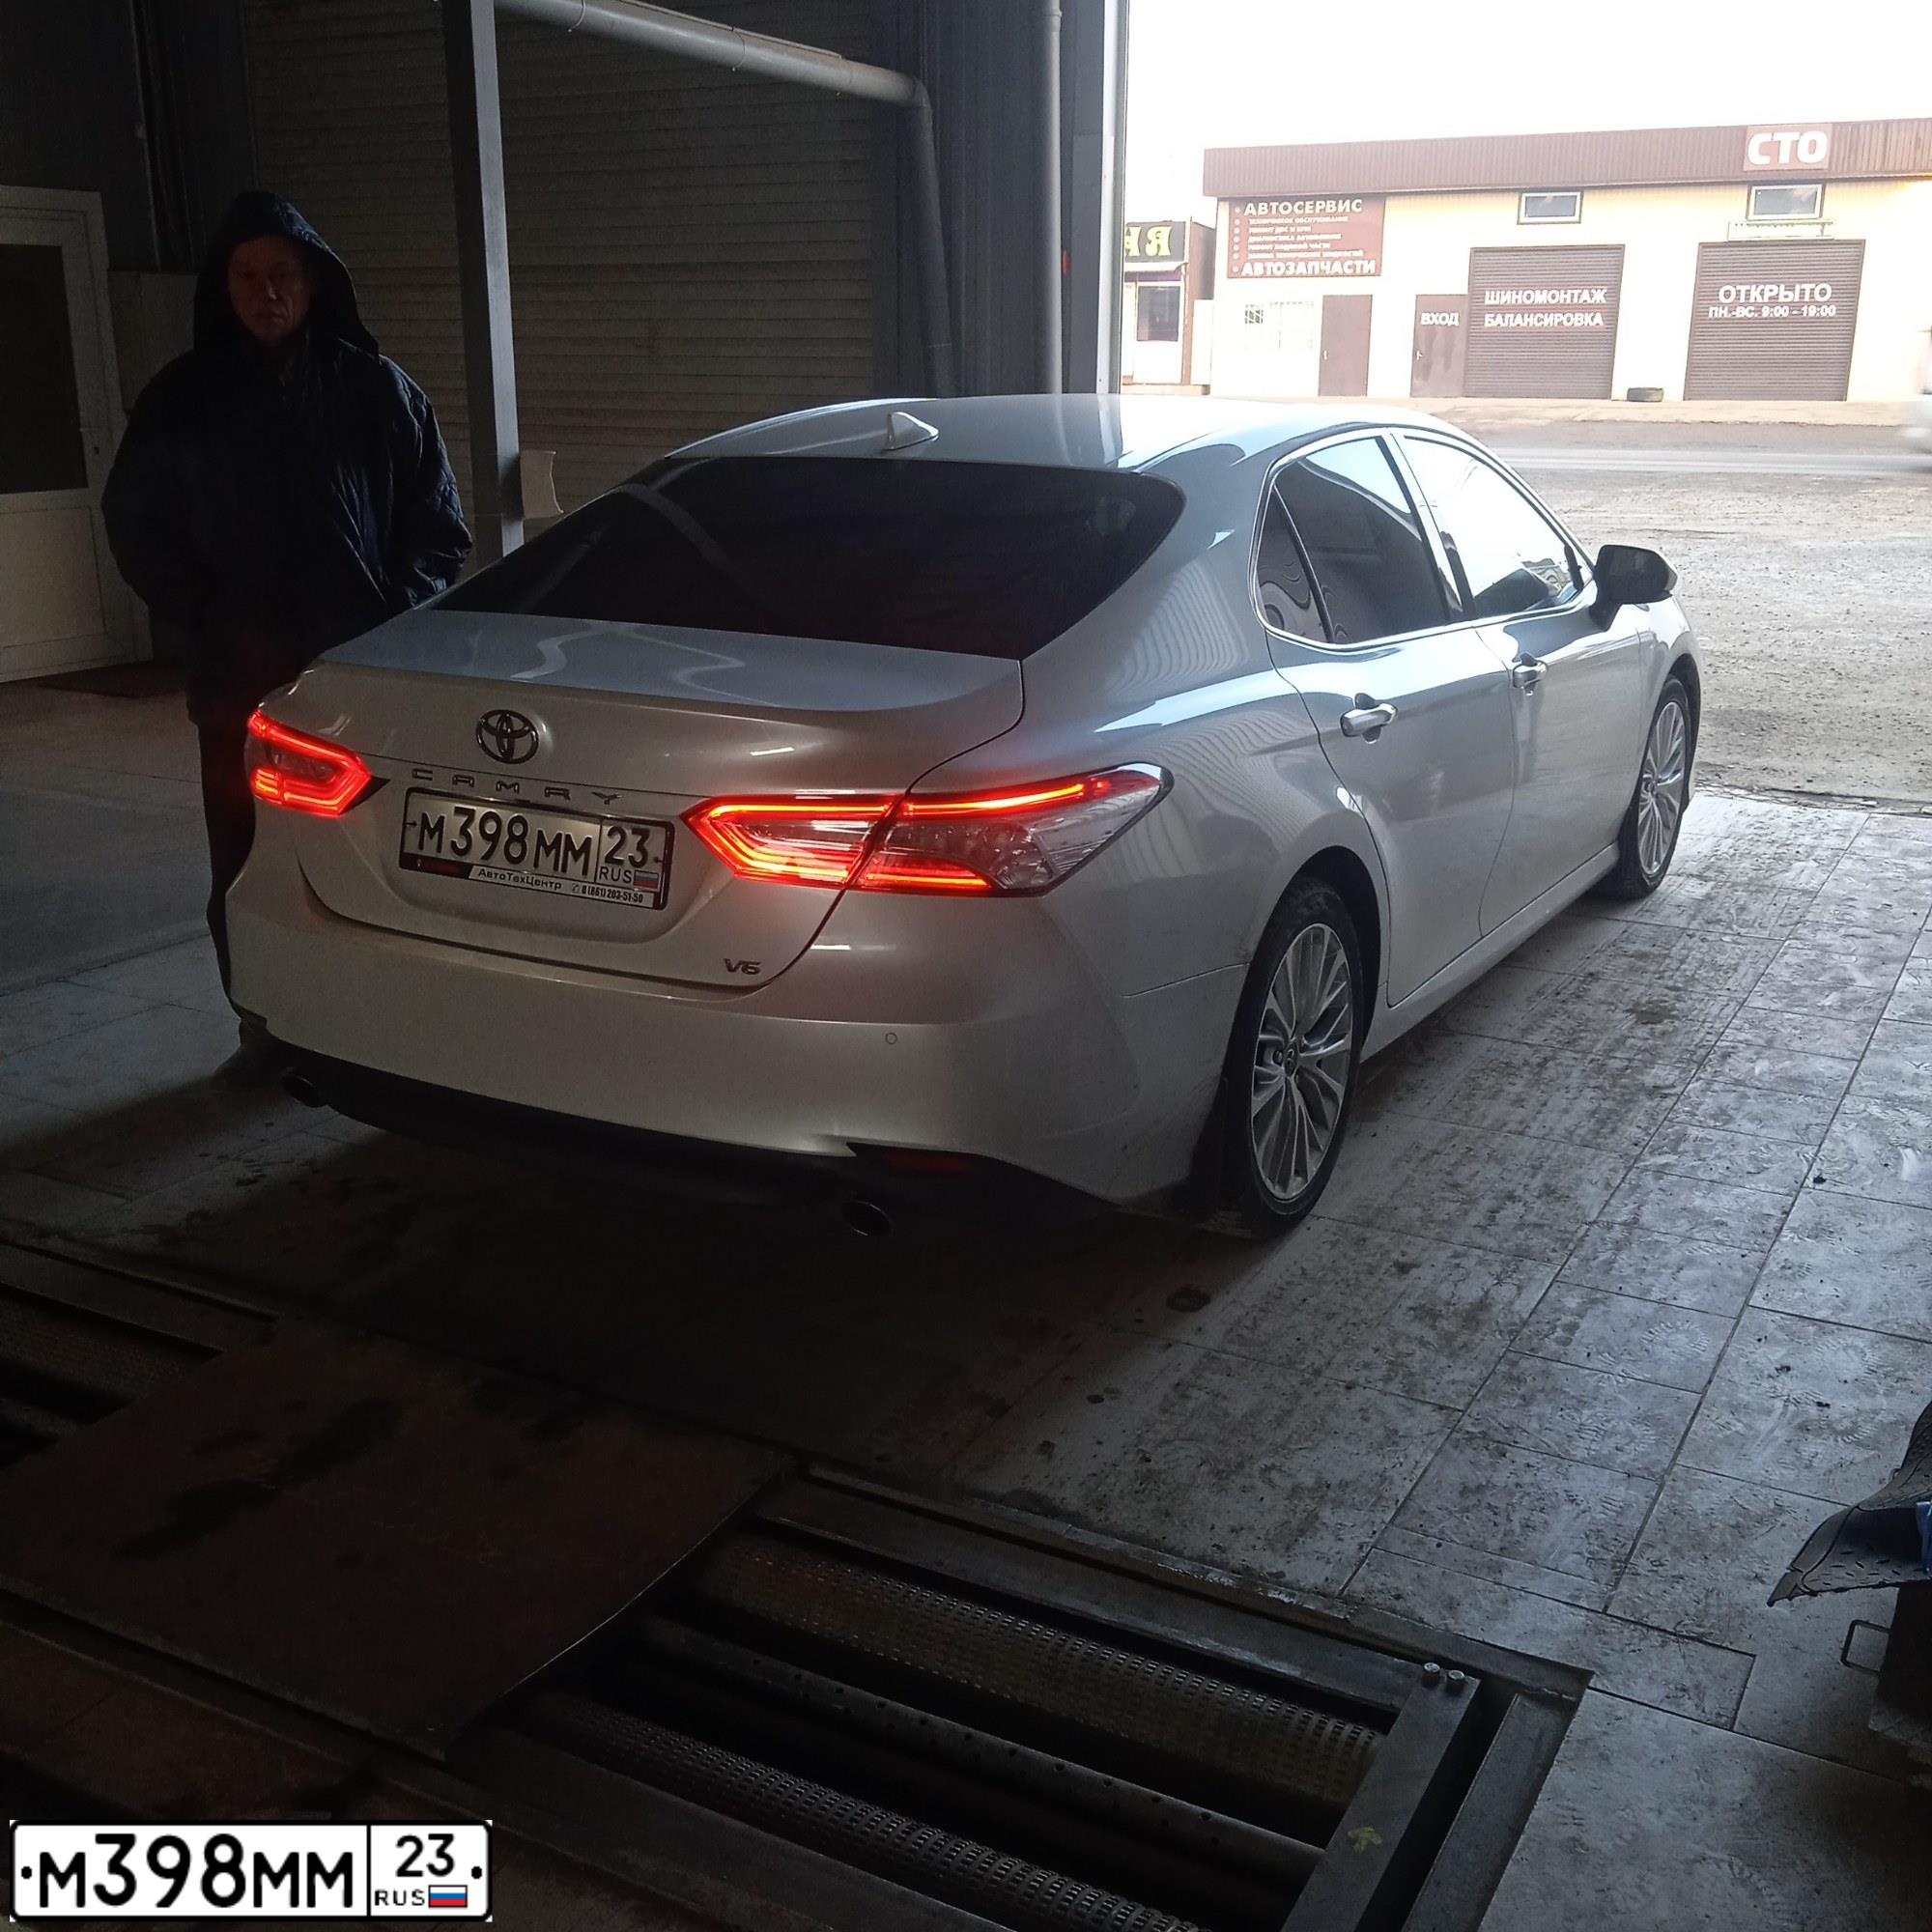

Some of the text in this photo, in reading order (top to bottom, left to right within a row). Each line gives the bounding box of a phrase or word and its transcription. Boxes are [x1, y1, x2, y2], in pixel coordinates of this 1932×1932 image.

[1747, 130, 1828, 165] СТО
[1243, 199, 1363, 215] АВТОСЕРВИС
[1241, 260, 1377, 275] АВТОЗАПЧАСТИ
[1484, 289, 1607, 305] ШИНОМОНТАЖ
[1719, 283, 1833, 303] ОТКРЫТО
[1421, 312, 1460, 326] ВХОД
[1484, 312, 1605, 327] БАЛАНСИРОВКА
[1761, 305, 1790, 318] 9:00
[1802, 304, 1836, 317] 19:00
[412, 768, 623, 806] CAMRY
[604, 825, 651, 868] 23
[598, 866, 633, 885] RUS
[724, 957, 761, 976] V6
